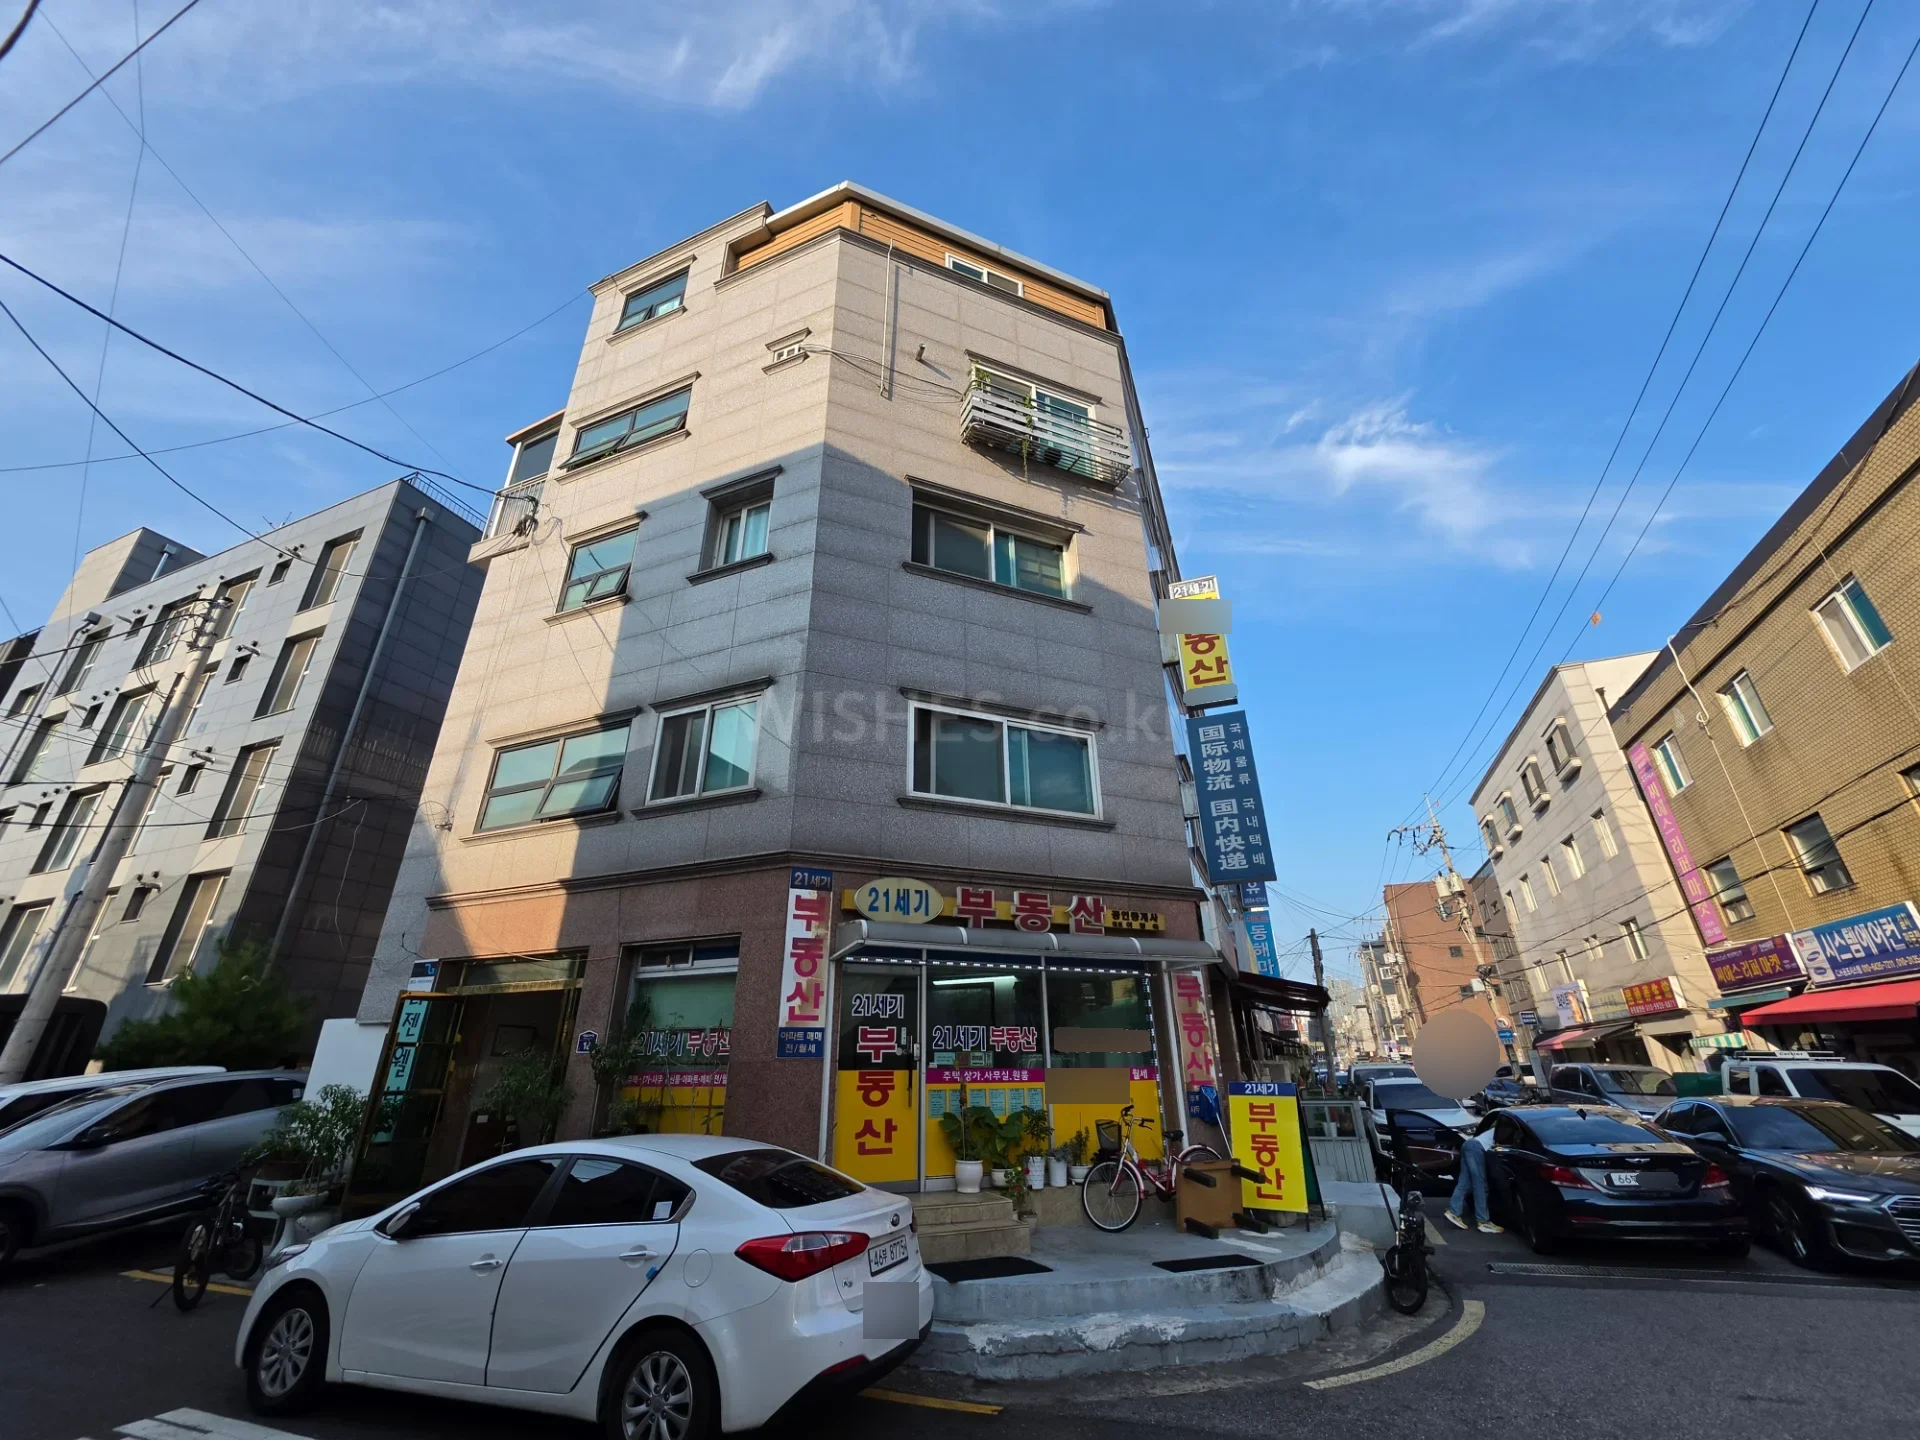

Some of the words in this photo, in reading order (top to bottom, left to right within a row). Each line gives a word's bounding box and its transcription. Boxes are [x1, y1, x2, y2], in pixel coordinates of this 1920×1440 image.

[1174, 580, 1214, 598] 21세기
[1198, 723, 1235, 791] 国际物流
[1229, 722, 1251, 785] 국제물류
[1242, 797, 1266, 866] 국내택배
[1210, 798, 1249, 871] 国内快递
[794, 872, 831, 888] 21세기
[867, 887, 930, 917] 21세기
[954, 886, 1107, 935] 부동산
[786, 895, 826, 1021] 부동산
[1820, 916, 1907, 962] 시스템에어컨
[851, 993, 904, 1019] 21세기
[780, 1031, 804, 1041] 아파트
[806, 1031, 822, 1041] 매매
[932, 1025, 987, 1051] 21세기
[989, 1026, 1037, 1053] 부동산
[1176, 974, 1215, 1087] 부동산
[854, 1026, 898, 1156] 부동산
[1132, 1068, 1148, 1080] 월세
[1245, 1083, 1279, 1096] 21세기
[1248, 1102, 1285, 1201] 부동산
